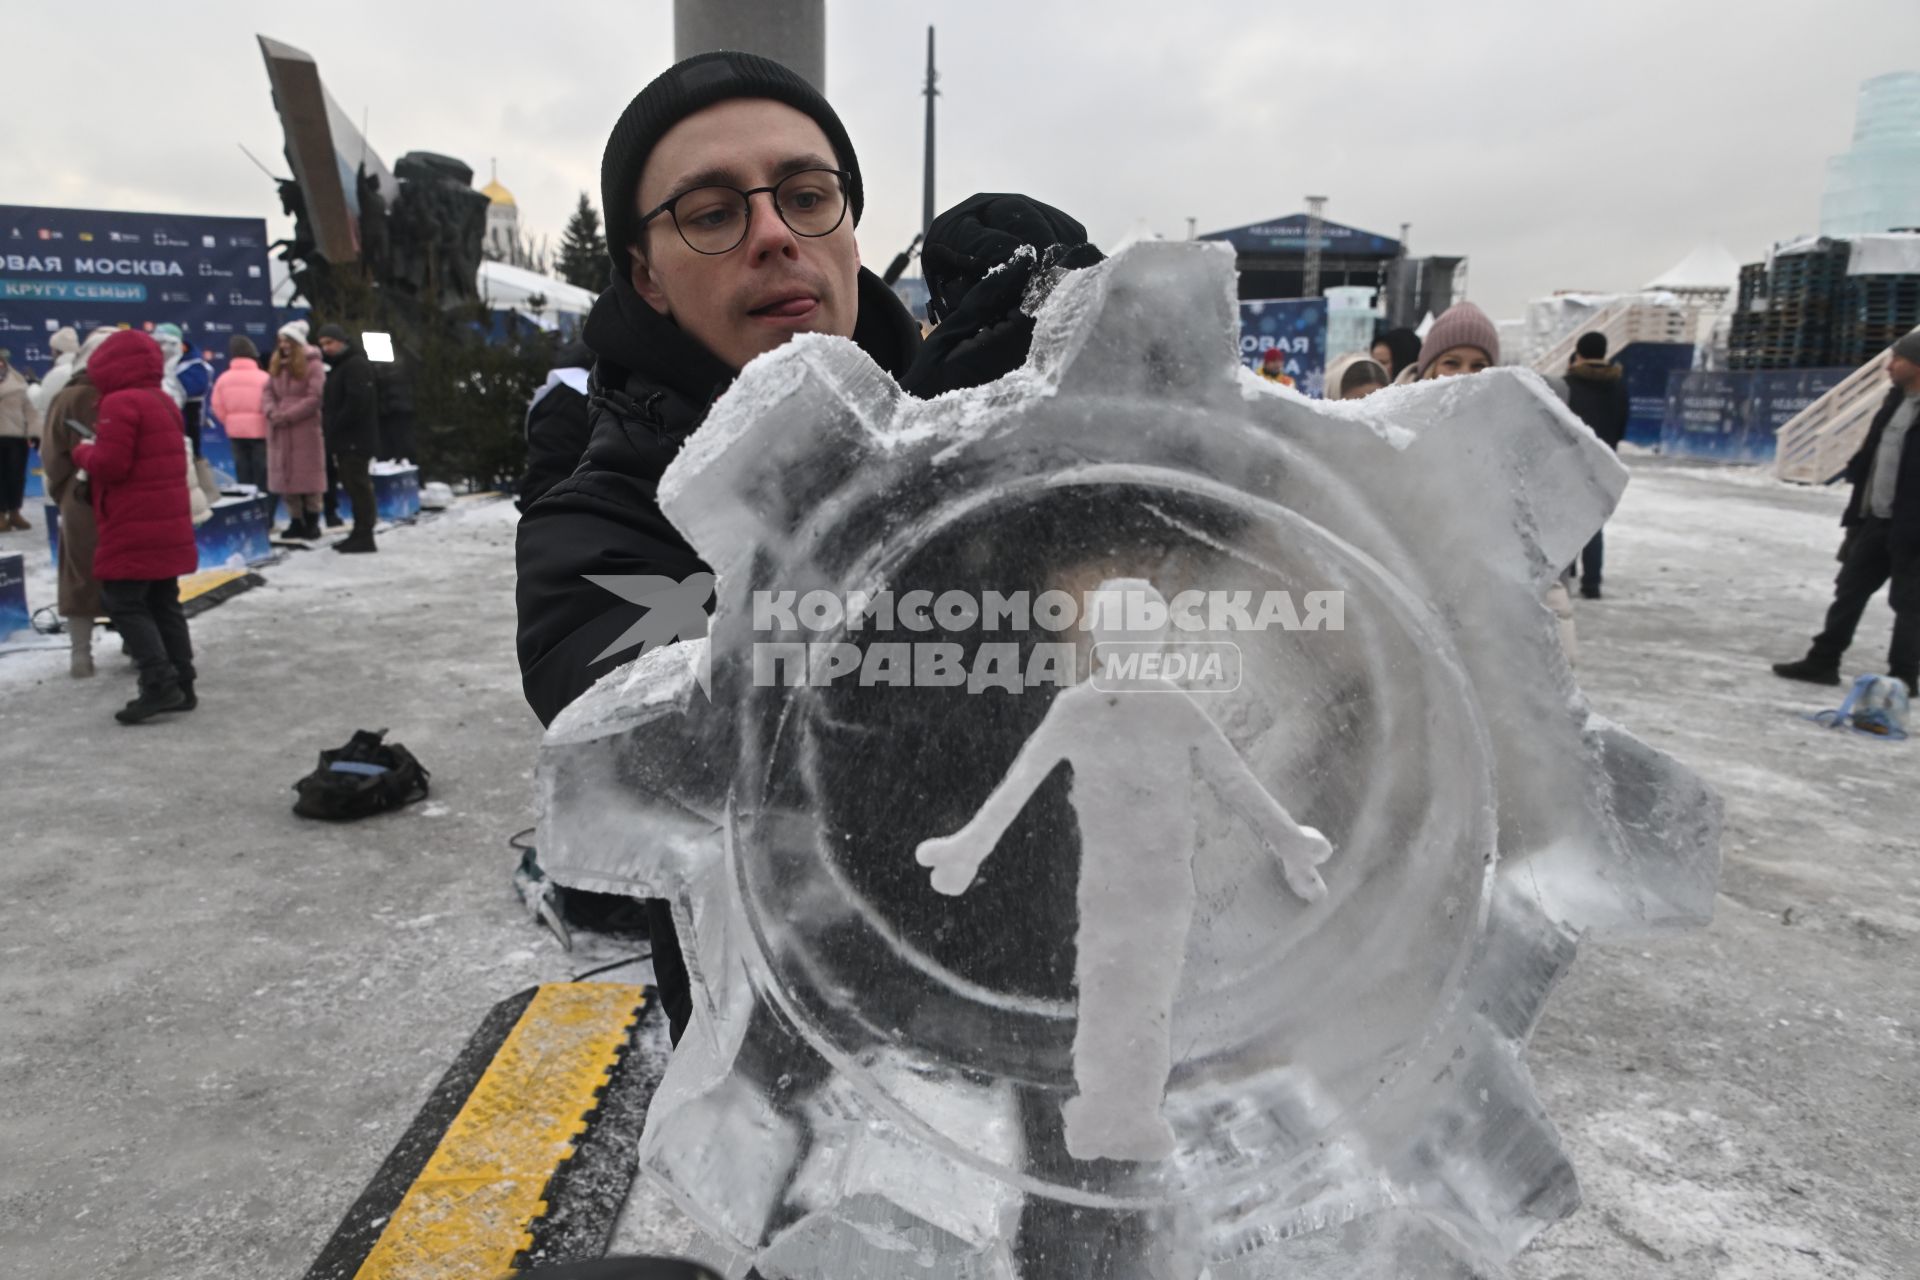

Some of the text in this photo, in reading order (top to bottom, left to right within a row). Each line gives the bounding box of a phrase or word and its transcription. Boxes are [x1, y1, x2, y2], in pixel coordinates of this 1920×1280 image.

[0, 254, 184, 276] ВАЯ МОСКВА
[5, 283, 141, 299] КРУГУ СЕМЬИ
